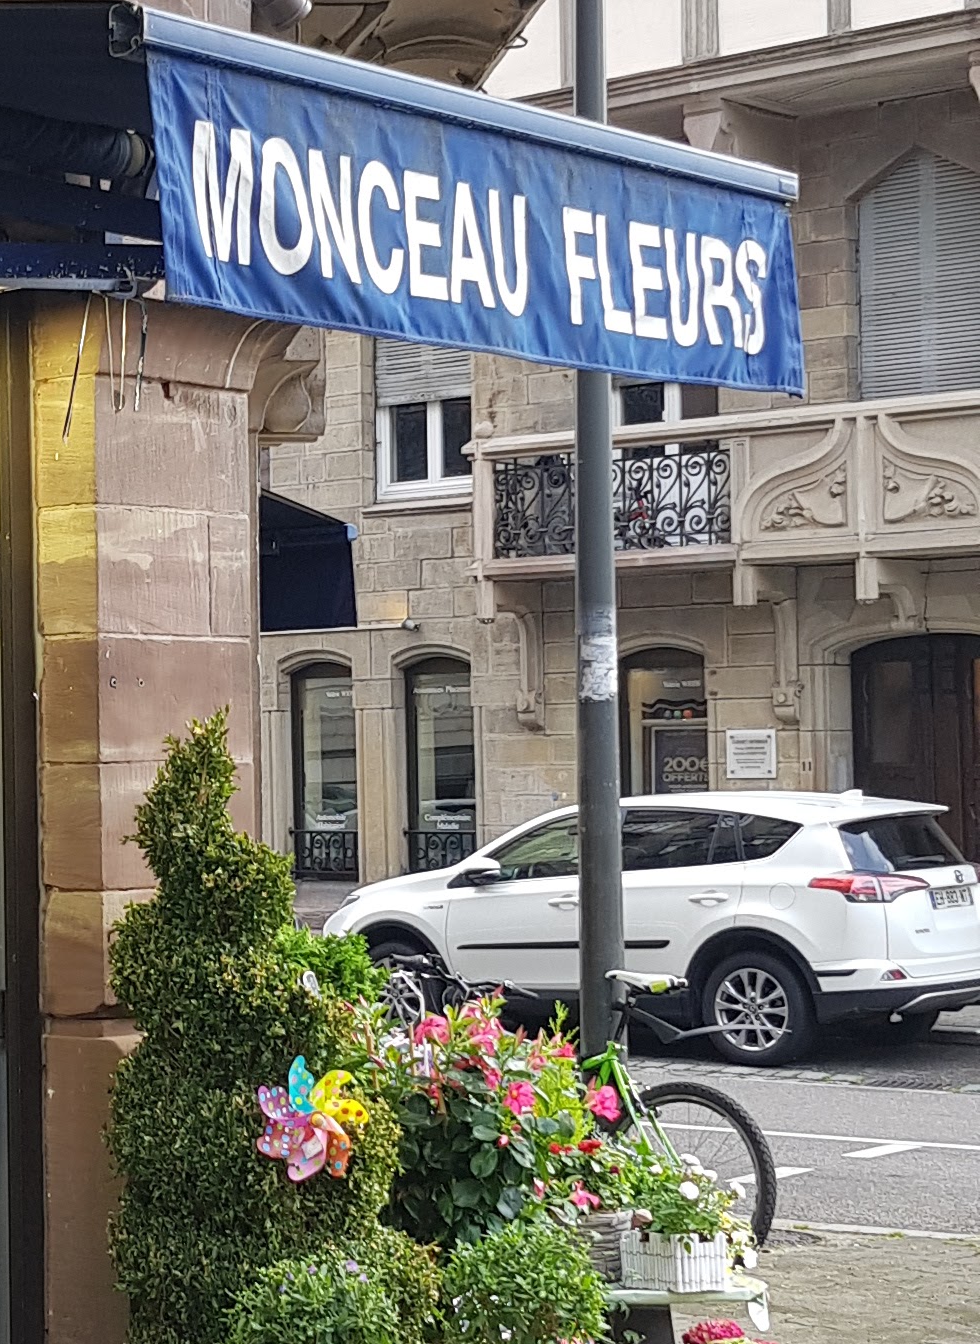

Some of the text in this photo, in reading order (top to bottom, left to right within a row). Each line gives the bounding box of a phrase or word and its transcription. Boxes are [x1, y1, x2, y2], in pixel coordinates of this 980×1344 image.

[192, 119, 768, 355] MONCEAU FLEURS
[663, 757, 708, 772] 200€
